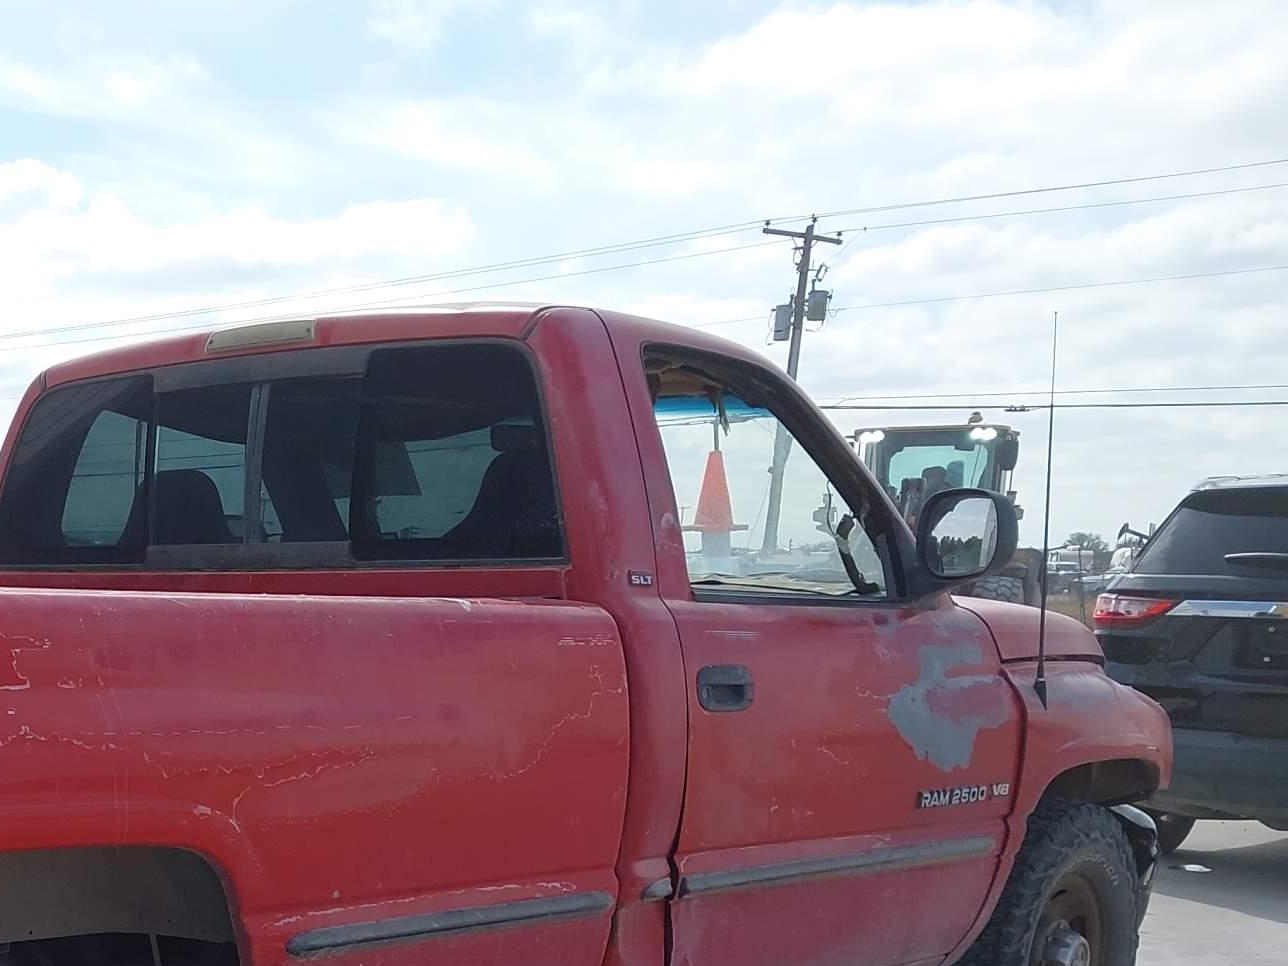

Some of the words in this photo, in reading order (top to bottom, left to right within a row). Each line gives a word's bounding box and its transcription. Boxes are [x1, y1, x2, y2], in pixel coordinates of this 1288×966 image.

[631, 575, 653, 585] SLT
[920, 789, 950, 808] RAM
[951, 785, 987, 805] 2500
[992, 783, 1010, 796] V8
